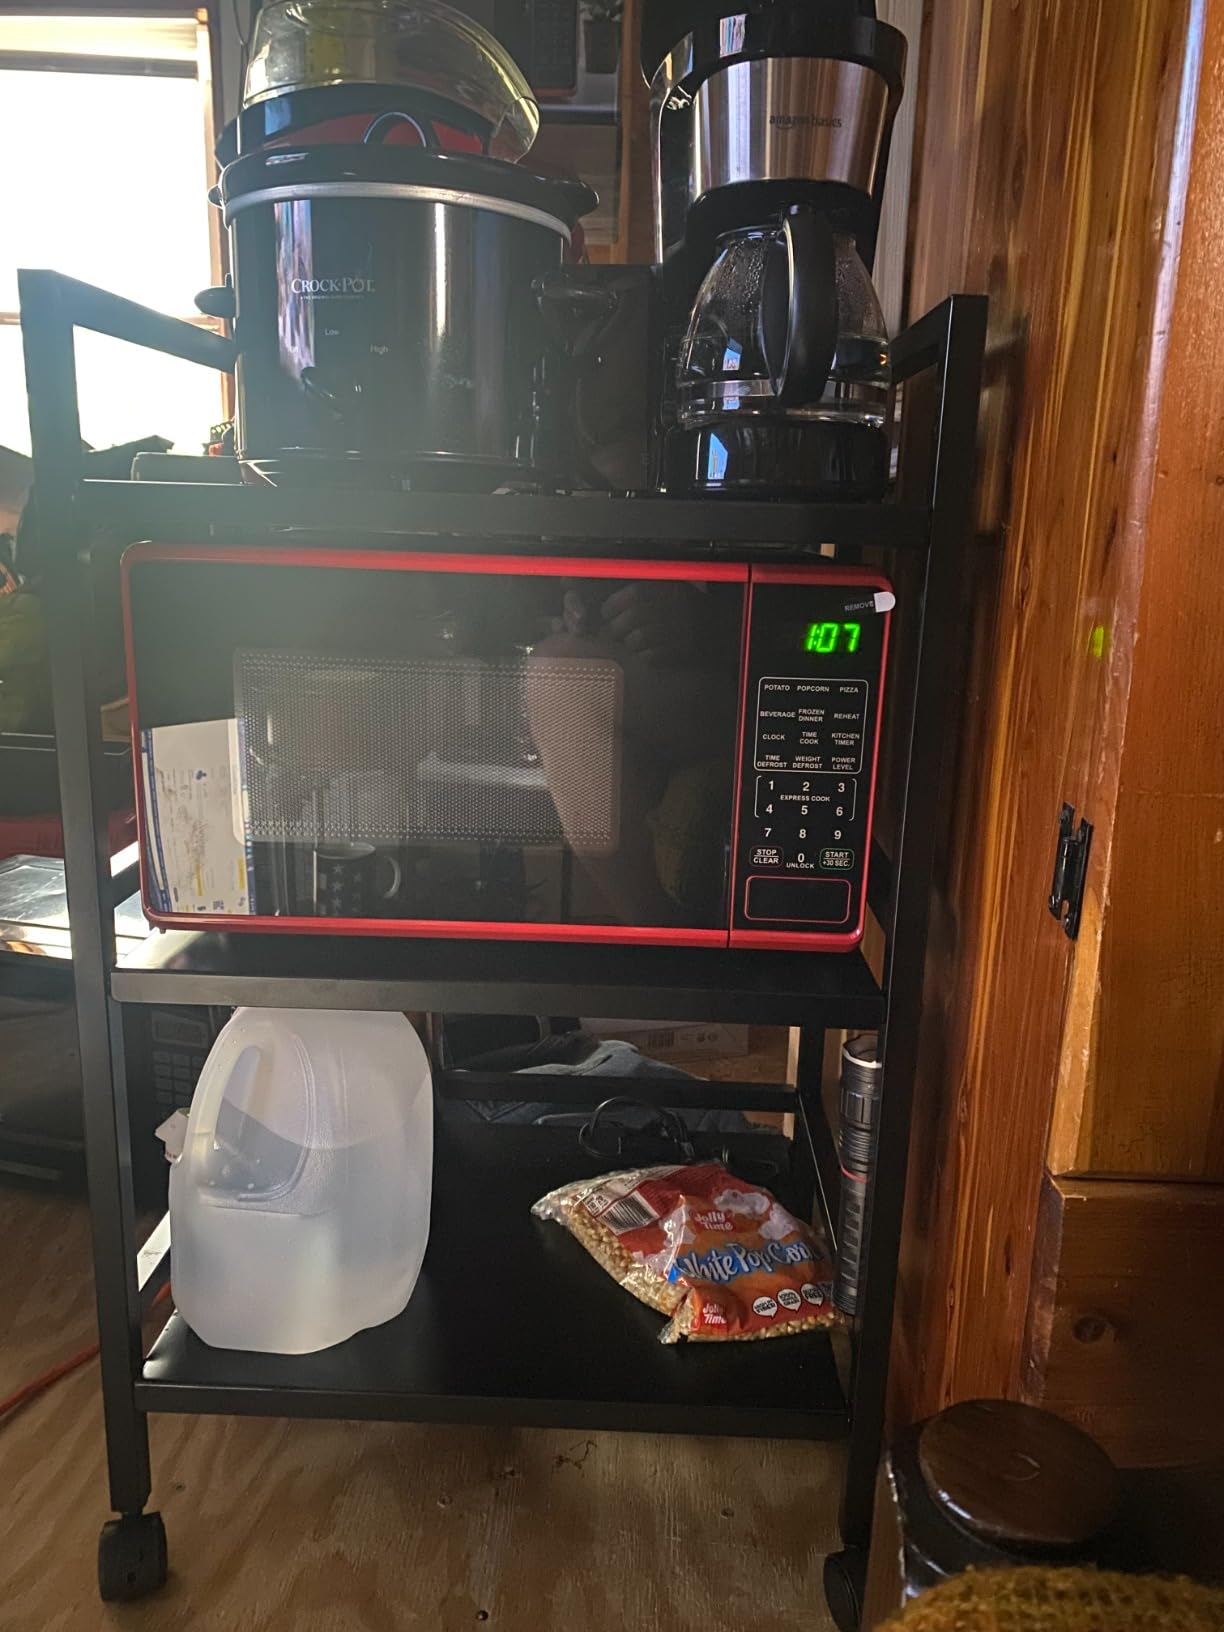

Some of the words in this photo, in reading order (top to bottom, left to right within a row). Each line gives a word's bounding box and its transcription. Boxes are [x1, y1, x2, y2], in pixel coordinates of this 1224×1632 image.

[844, 600, 875, 612] REMOVE
[806, 622, 861, 653] 1:07
[764, 684, 790, 692] POTATO
[768, 780, 774, 790] 1
[802, 781, 810, 792] 2
[838, 782, 845, 793] 3
[780, 794, 810, 802] EXPRESS
[765, 804, 773, 814] 4
[801, 805, 808, 815] 5
[836, 806, 844, 816] 6
[764, 828, 772, 837] 7
[799, 829, 807, 838] 8
[834, 830, 842, 840] 9
[797, 853, 805, 863] 0
[694, 1211, 726, 1223] Jolly
[702, 1221, 734, 1232] Time
[675, 1250, 738, 1281] White
